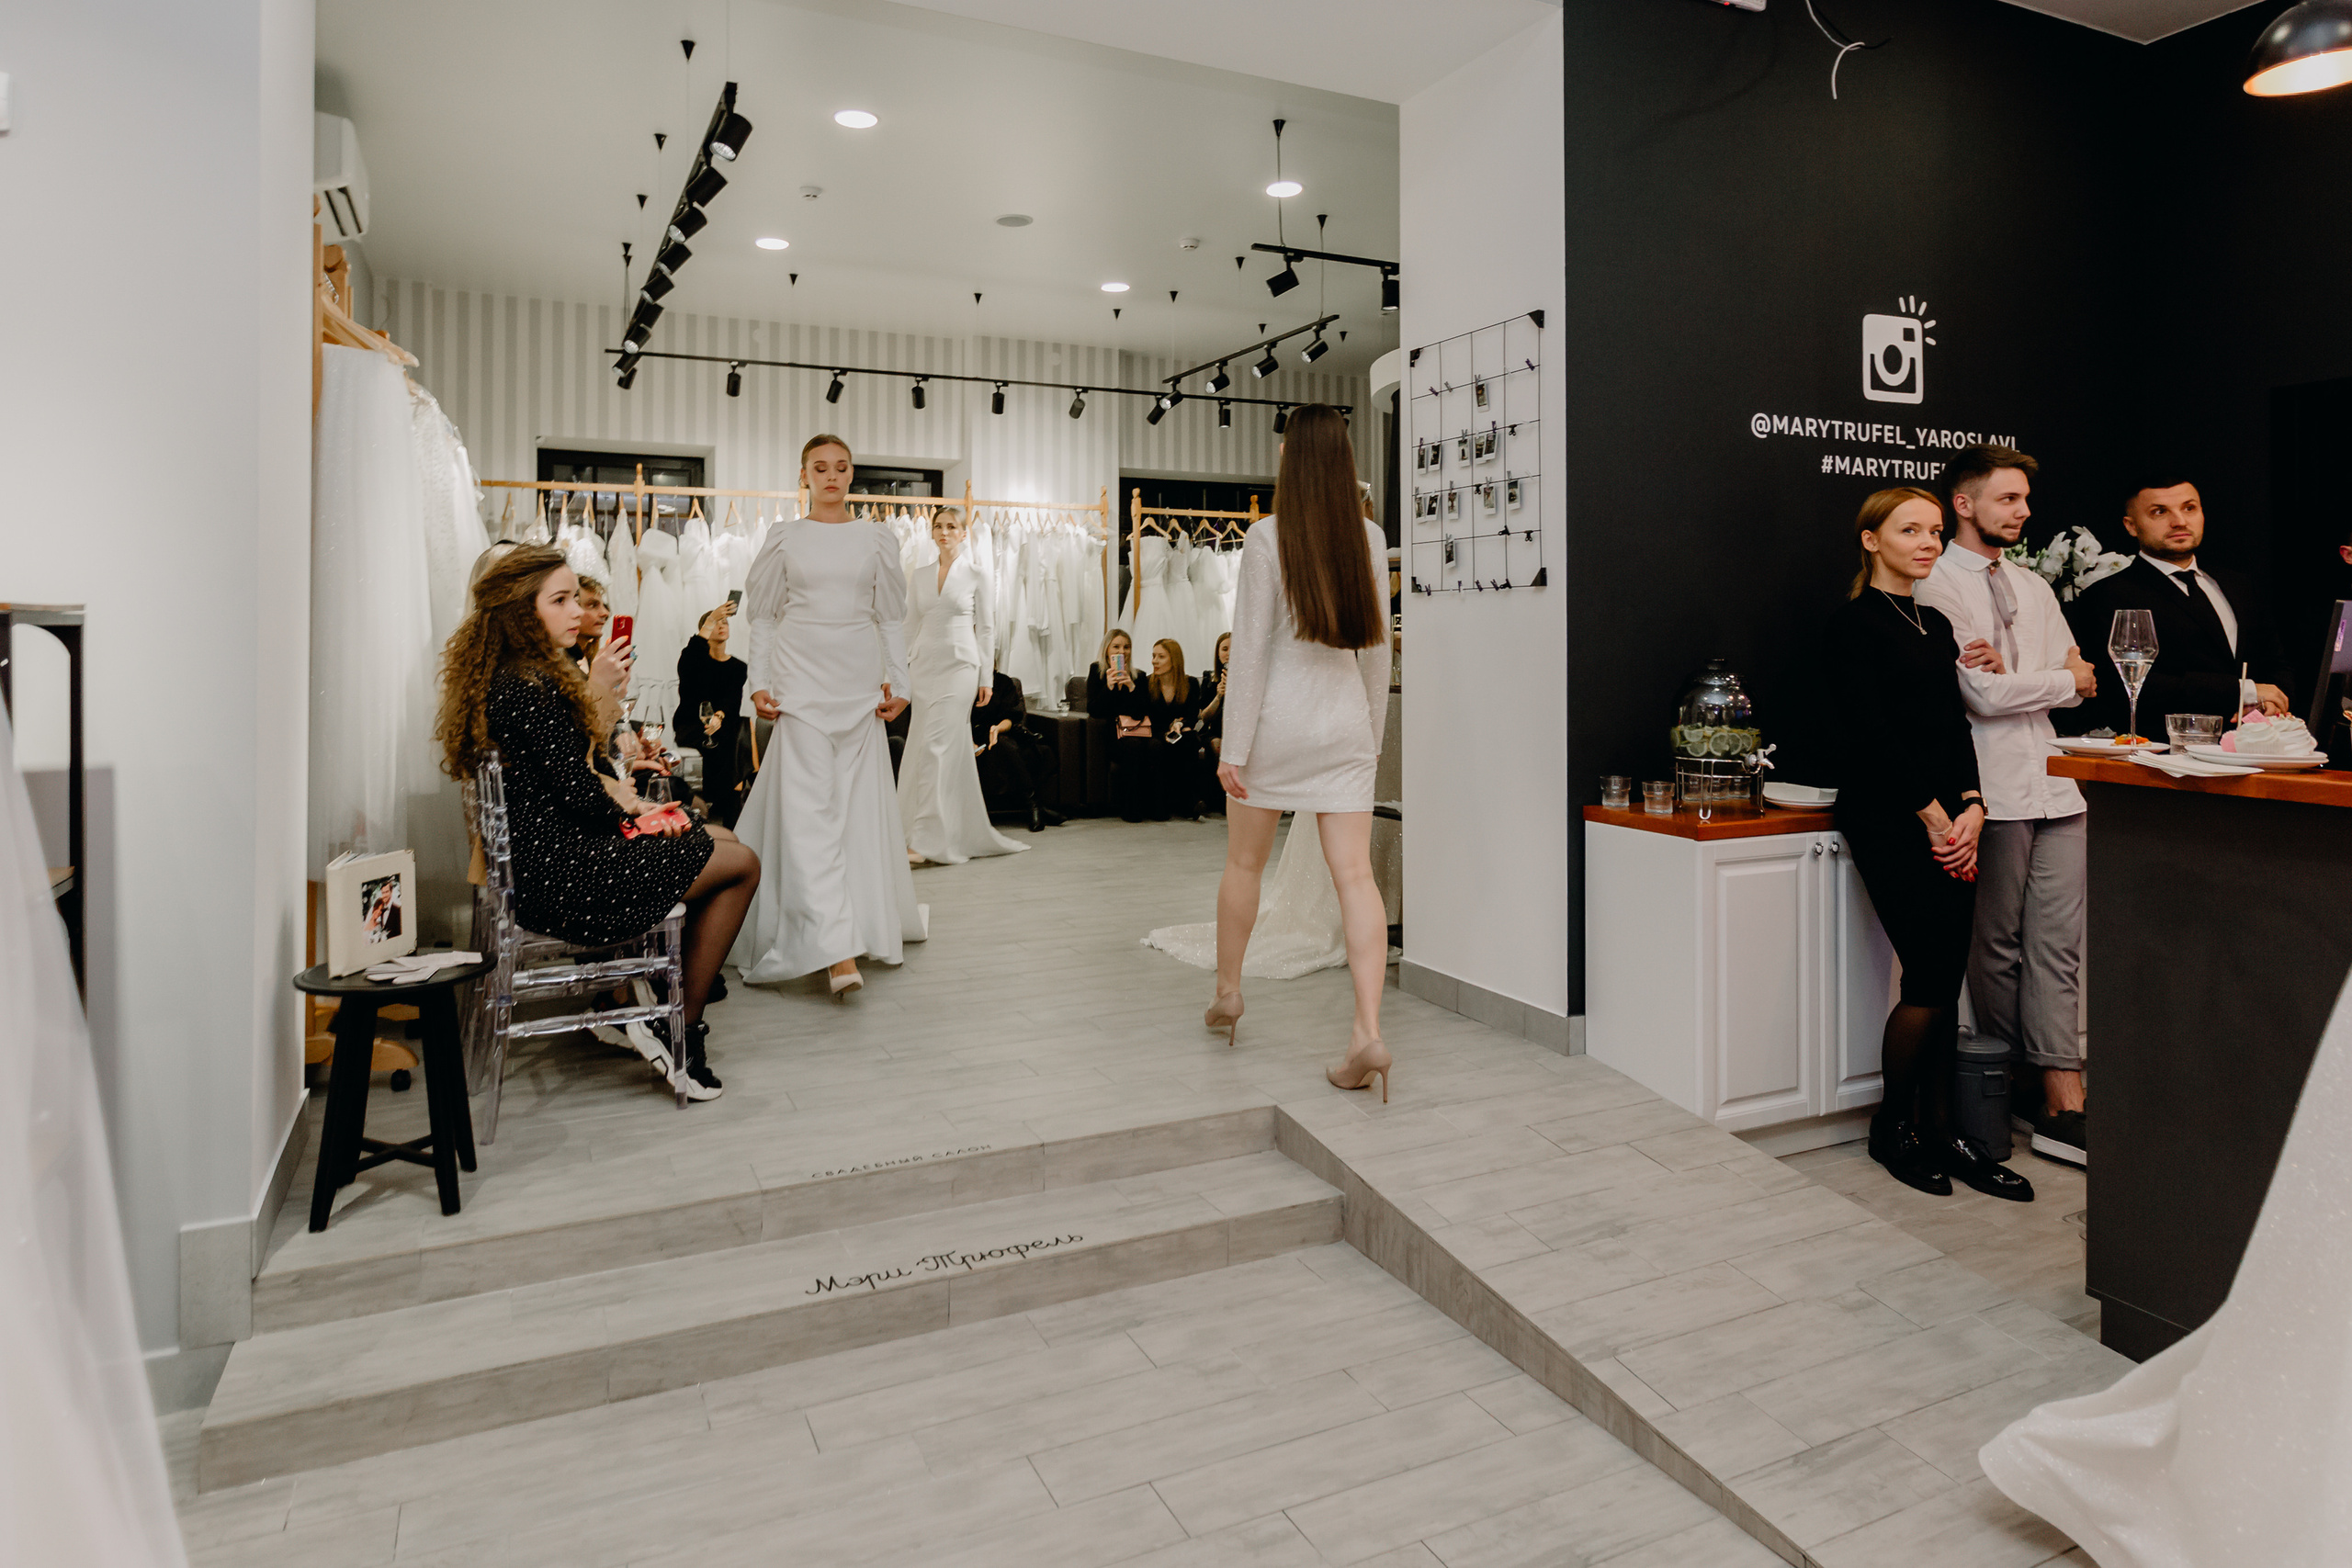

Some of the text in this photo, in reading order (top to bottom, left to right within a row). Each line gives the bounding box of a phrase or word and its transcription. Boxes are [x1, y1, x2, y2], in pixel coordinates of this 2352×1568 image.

[1821, 455, 1946, 480] #MARYTRUF
[811, 1144, 992, 1179] СВАДЕБНЫЙ САЛОН
[805, 1234, 1084, 1295] Мэри Трюфель
